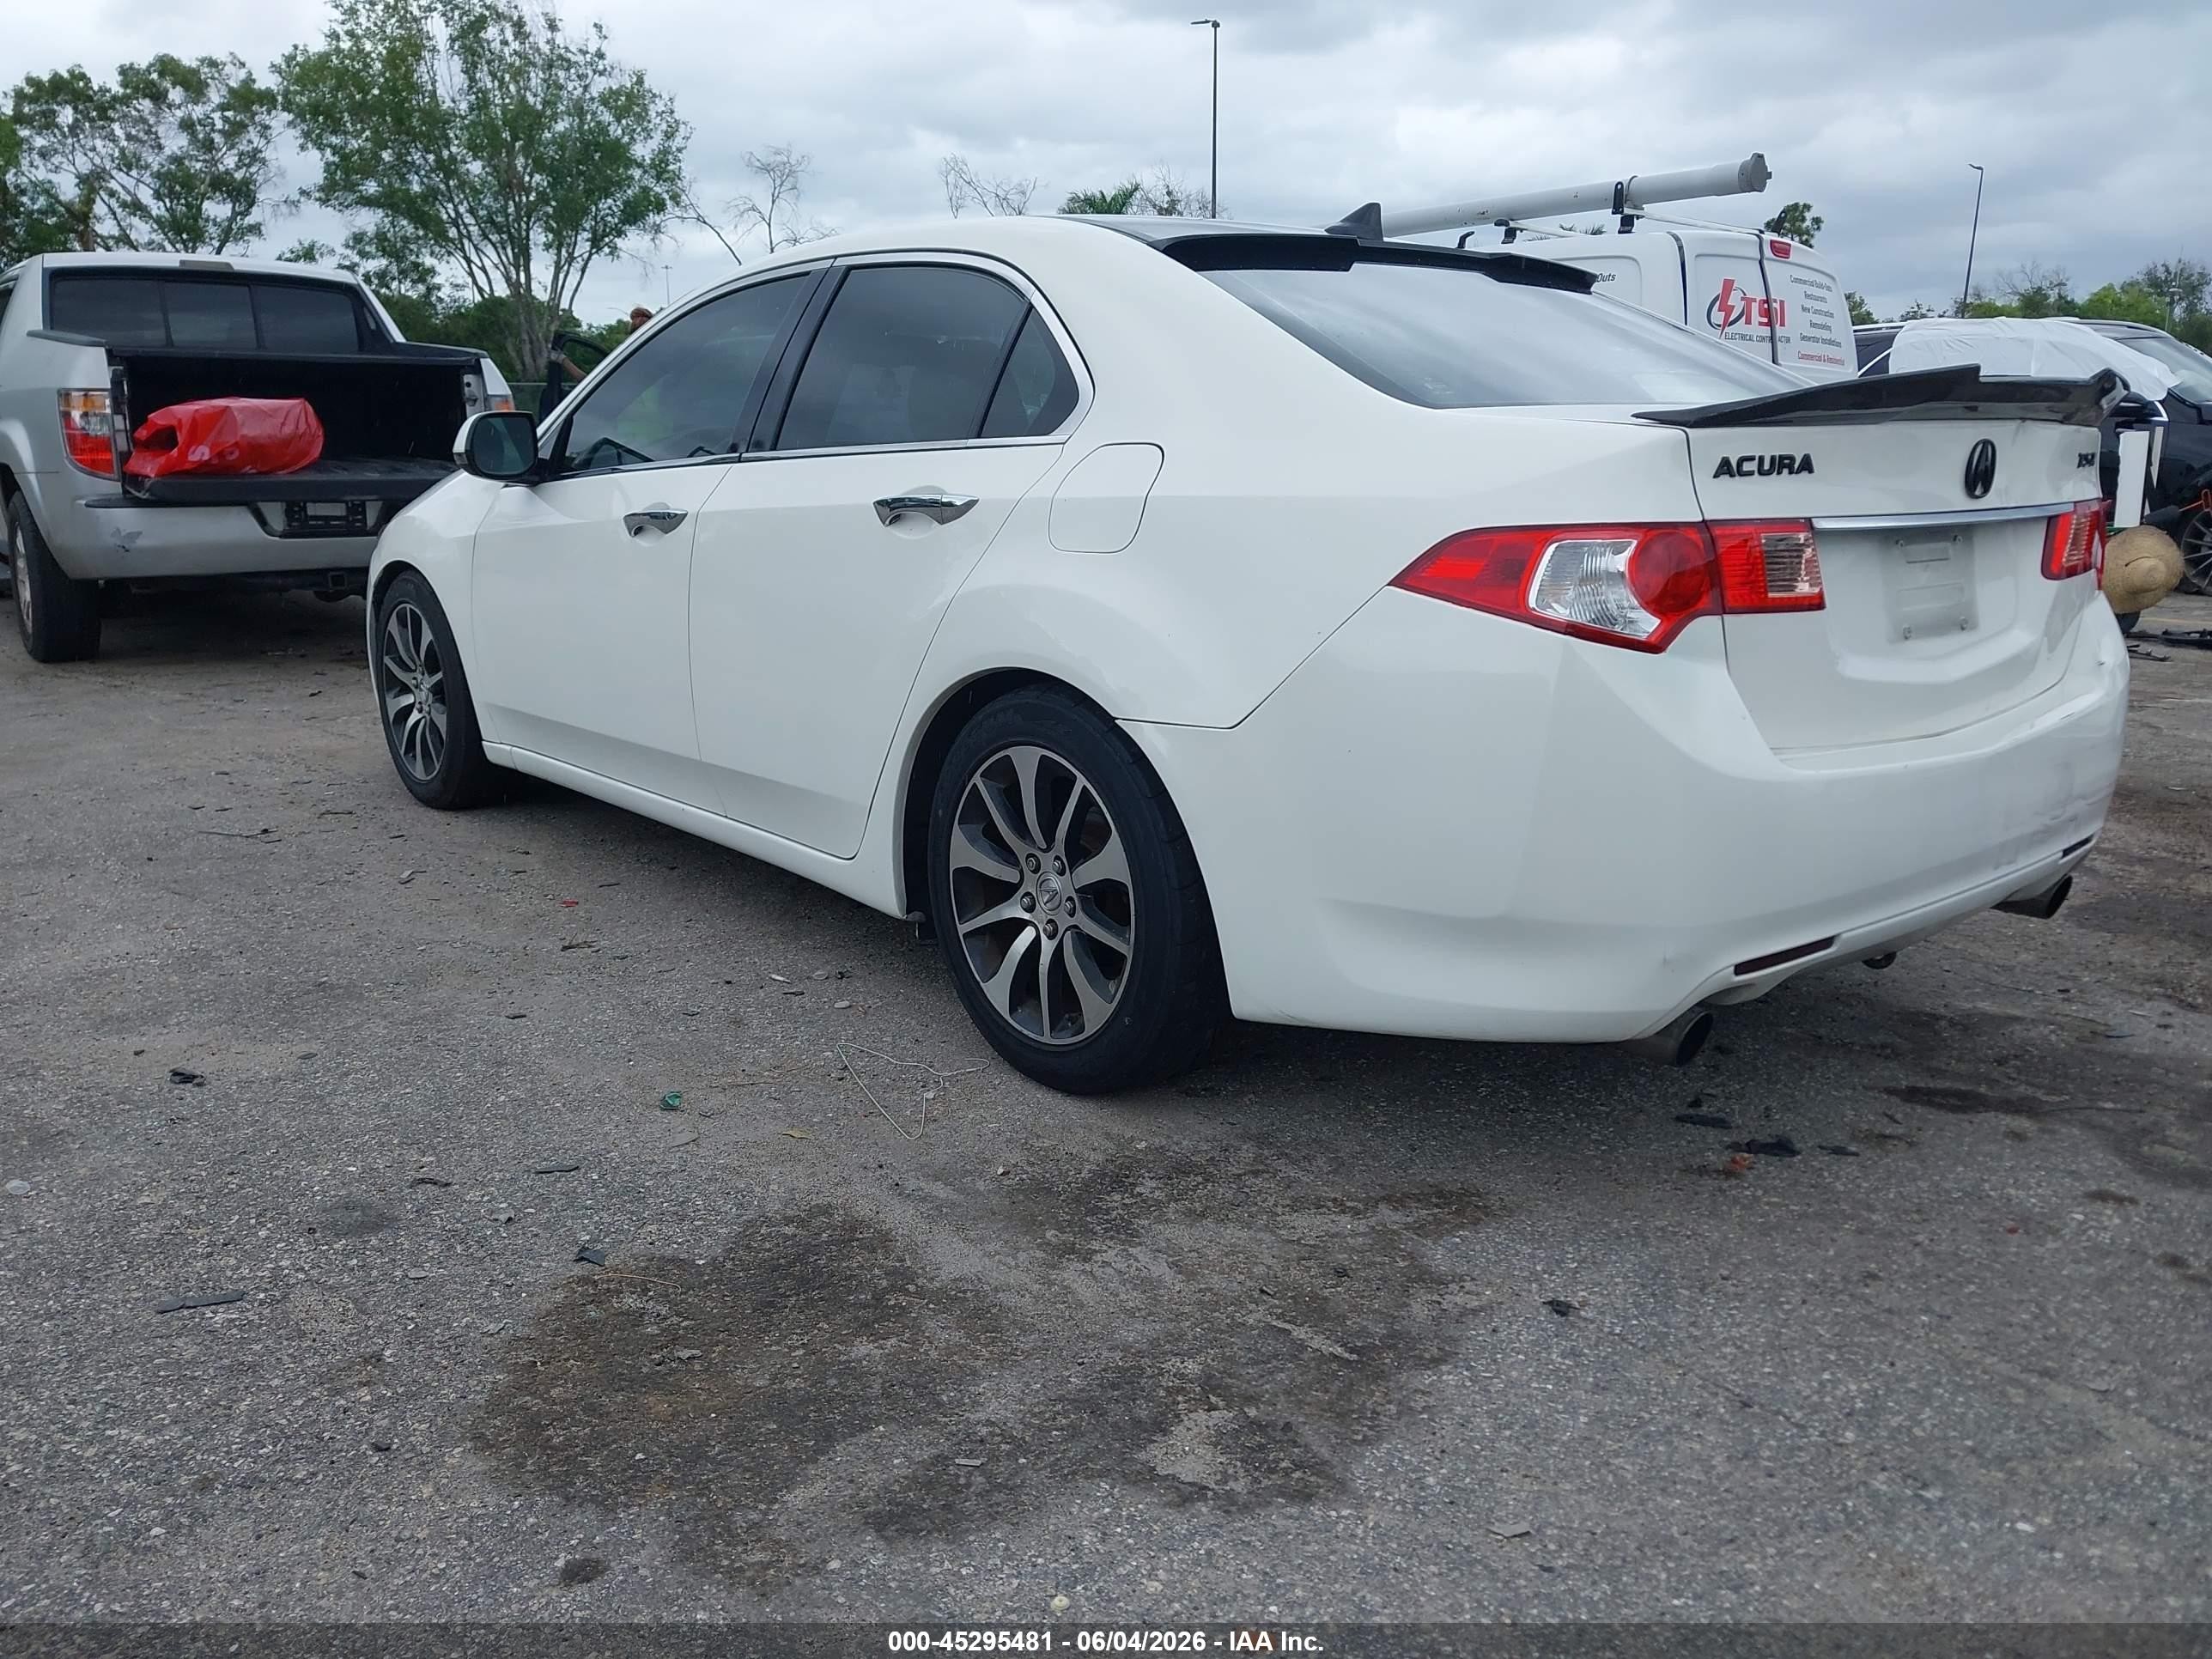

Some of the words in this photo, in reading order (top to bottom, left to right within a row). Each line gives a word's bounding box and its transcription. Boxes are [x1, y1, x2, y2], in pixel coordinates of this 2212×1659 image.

[1790, 275, 1814, 288] Commercial
[1741, 296, 1786, 327] TSI
[1802, 304, 1810, 313] New
[1811, 306, 1834, 319] Construction
[1810, 319, 1832, 333] Remodeling
[1724, 332, 1755, 342] ELECTRICAL
[1800, 332, 1820, 343] Generator
[1798, 350, 1822, 362] Commercial
[1713, 453, 1814, 478] ACURA
